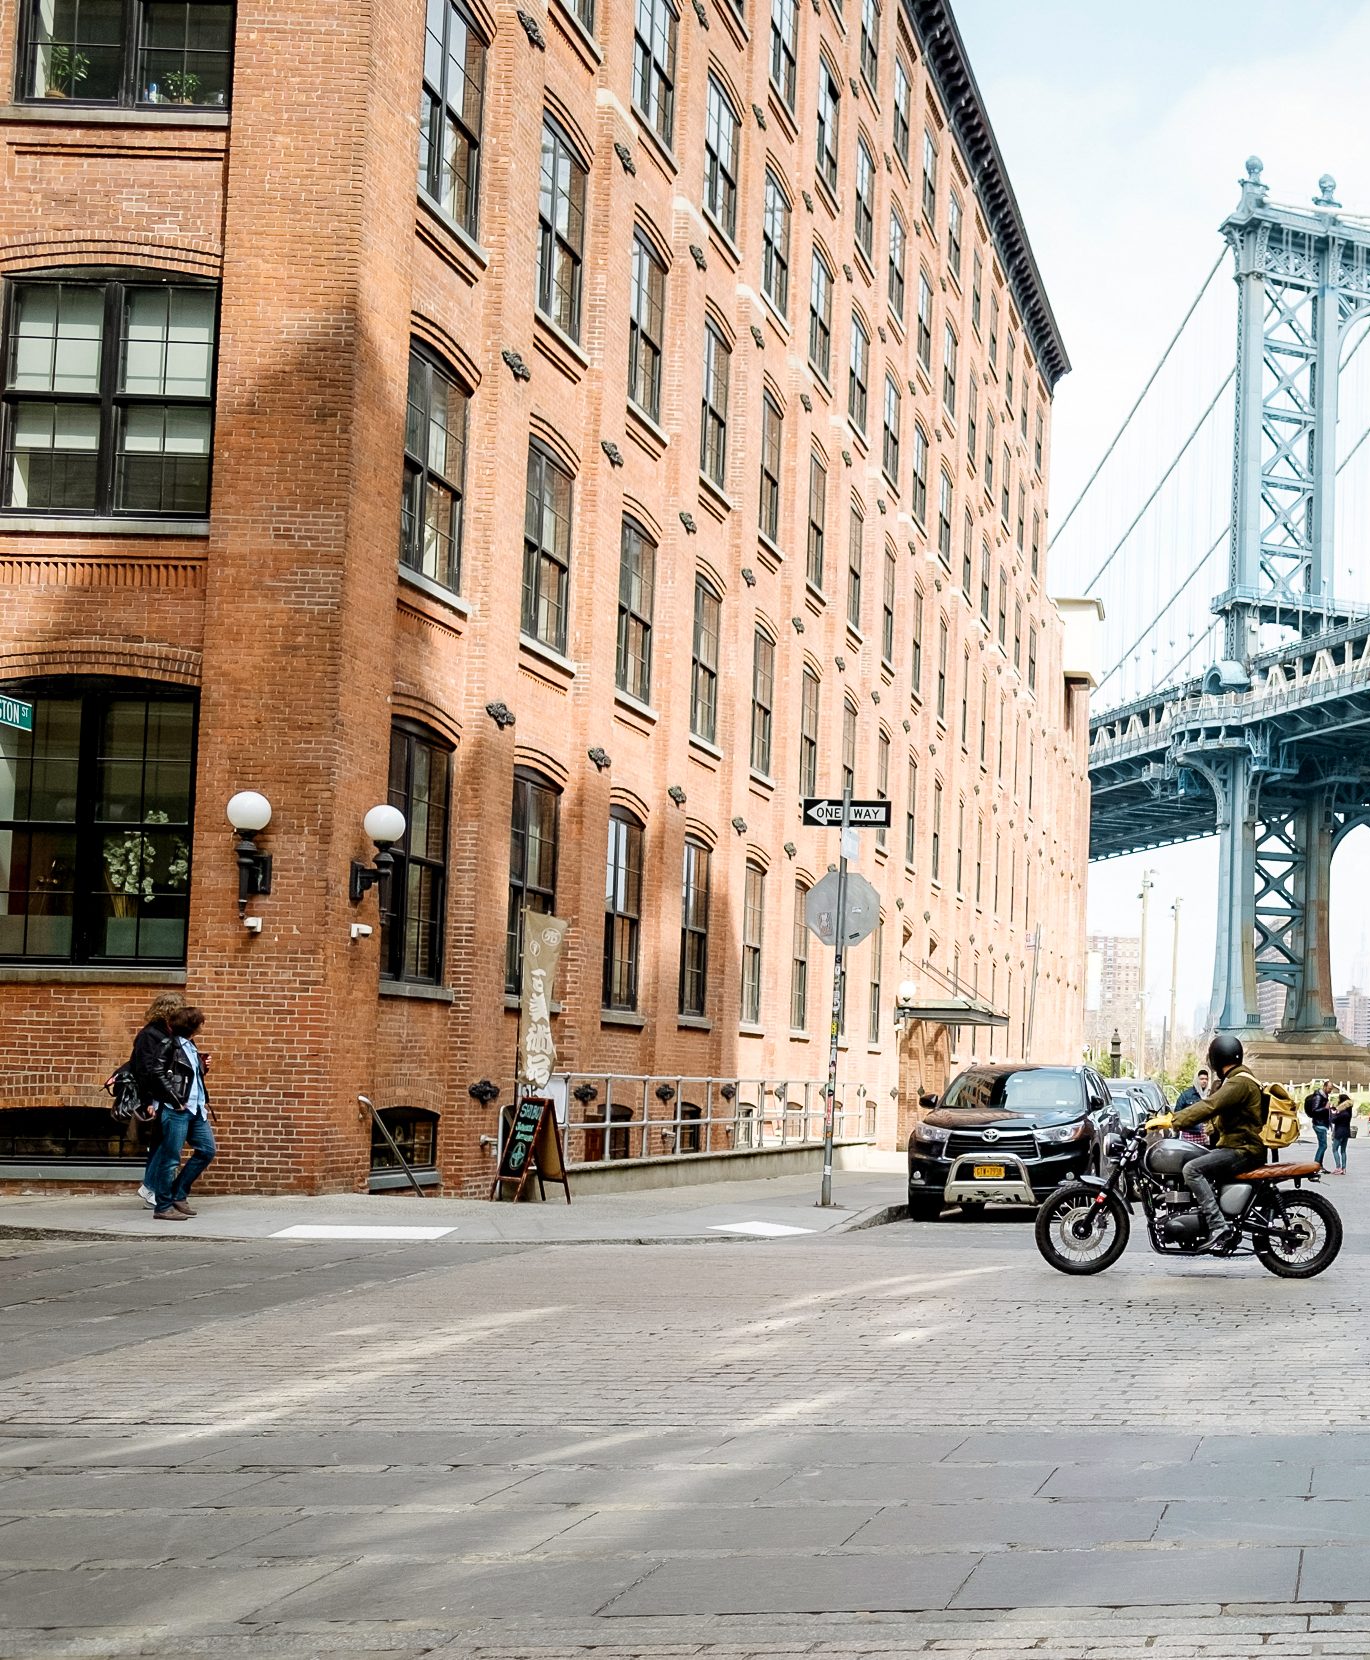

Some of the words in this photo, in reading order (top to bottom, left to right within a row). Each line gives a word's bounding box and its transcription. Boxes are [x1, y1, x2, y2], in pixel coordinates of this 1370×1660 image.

[22, 706, 28, 718] ST
[816, 807, 841, 819] ONE
[853, 808, 880, 820] WAY
